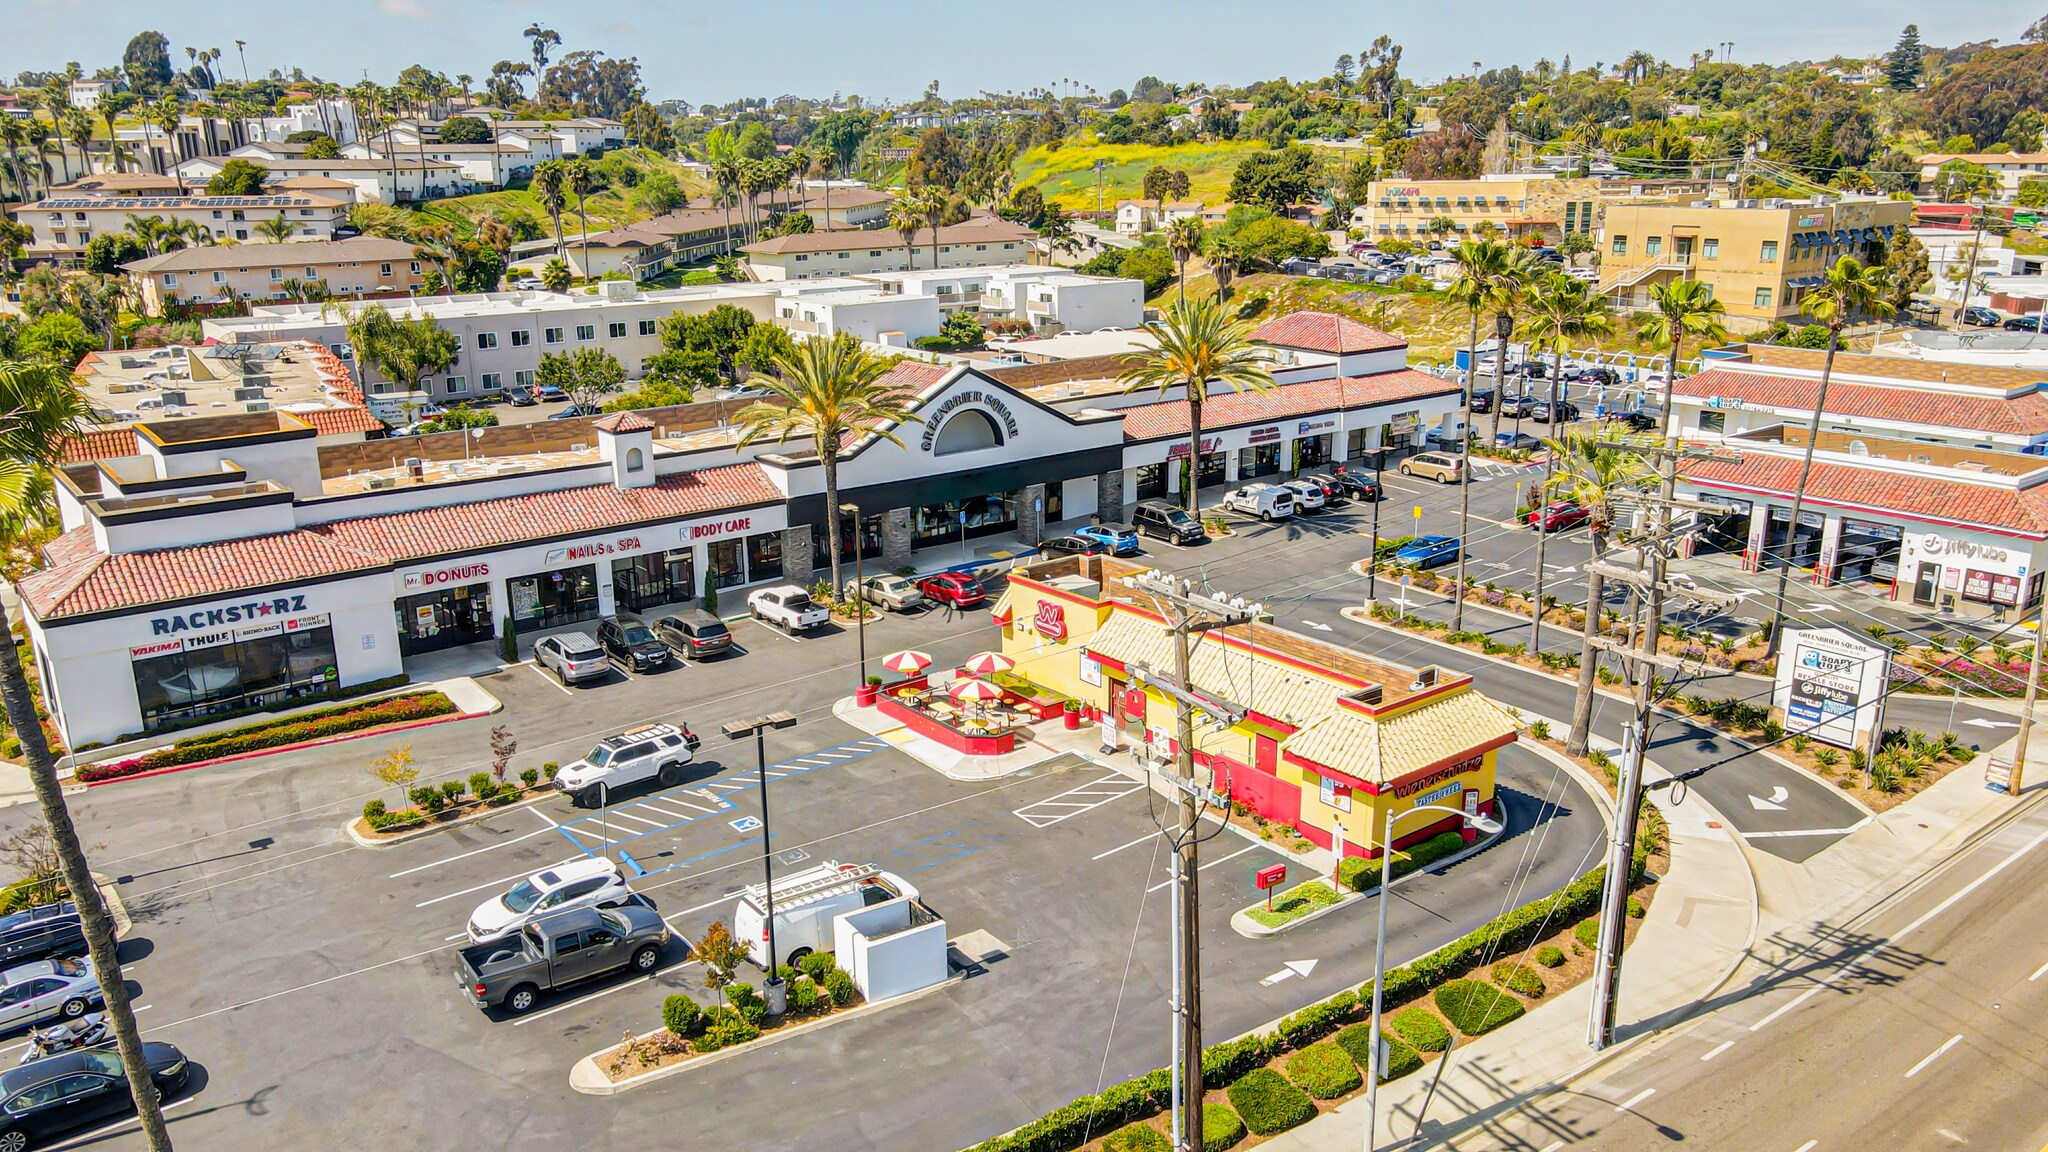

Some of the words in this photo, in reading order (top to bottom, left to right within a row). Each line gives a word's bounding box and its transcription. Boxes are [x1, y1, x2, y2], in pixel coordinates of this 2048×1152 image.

[921, 391, 982, 451] GREENBRIER
[984, 394, 1019, 439] SQUARE
[695, 522, 723, 538] BODY
[725, 517, 751, 533] CARE
[567, 543, 605, 560] NAILS
[607, 544, 614, 554] &
[617, 536, 641, 551] SPA
[407, 577, 420, 585] Mr.
[424, 563, 490, 585] DONUTS
[299, 619, 325, 628] RUNNER
[188, 632, 229, 647] THULE
[1798, 632, 1840, 646] GREENBRIER
[1841, 641, 1868, 652] SQUARE
[132, 641, 181, 656] YAKIMA
[1822, 655, 1852, 666] SOAPY
[1814, 686, 1832, 698] jiffy
[1832, 692, 1849, 701] lube
[1829, 681, 1855, 693] STORE
